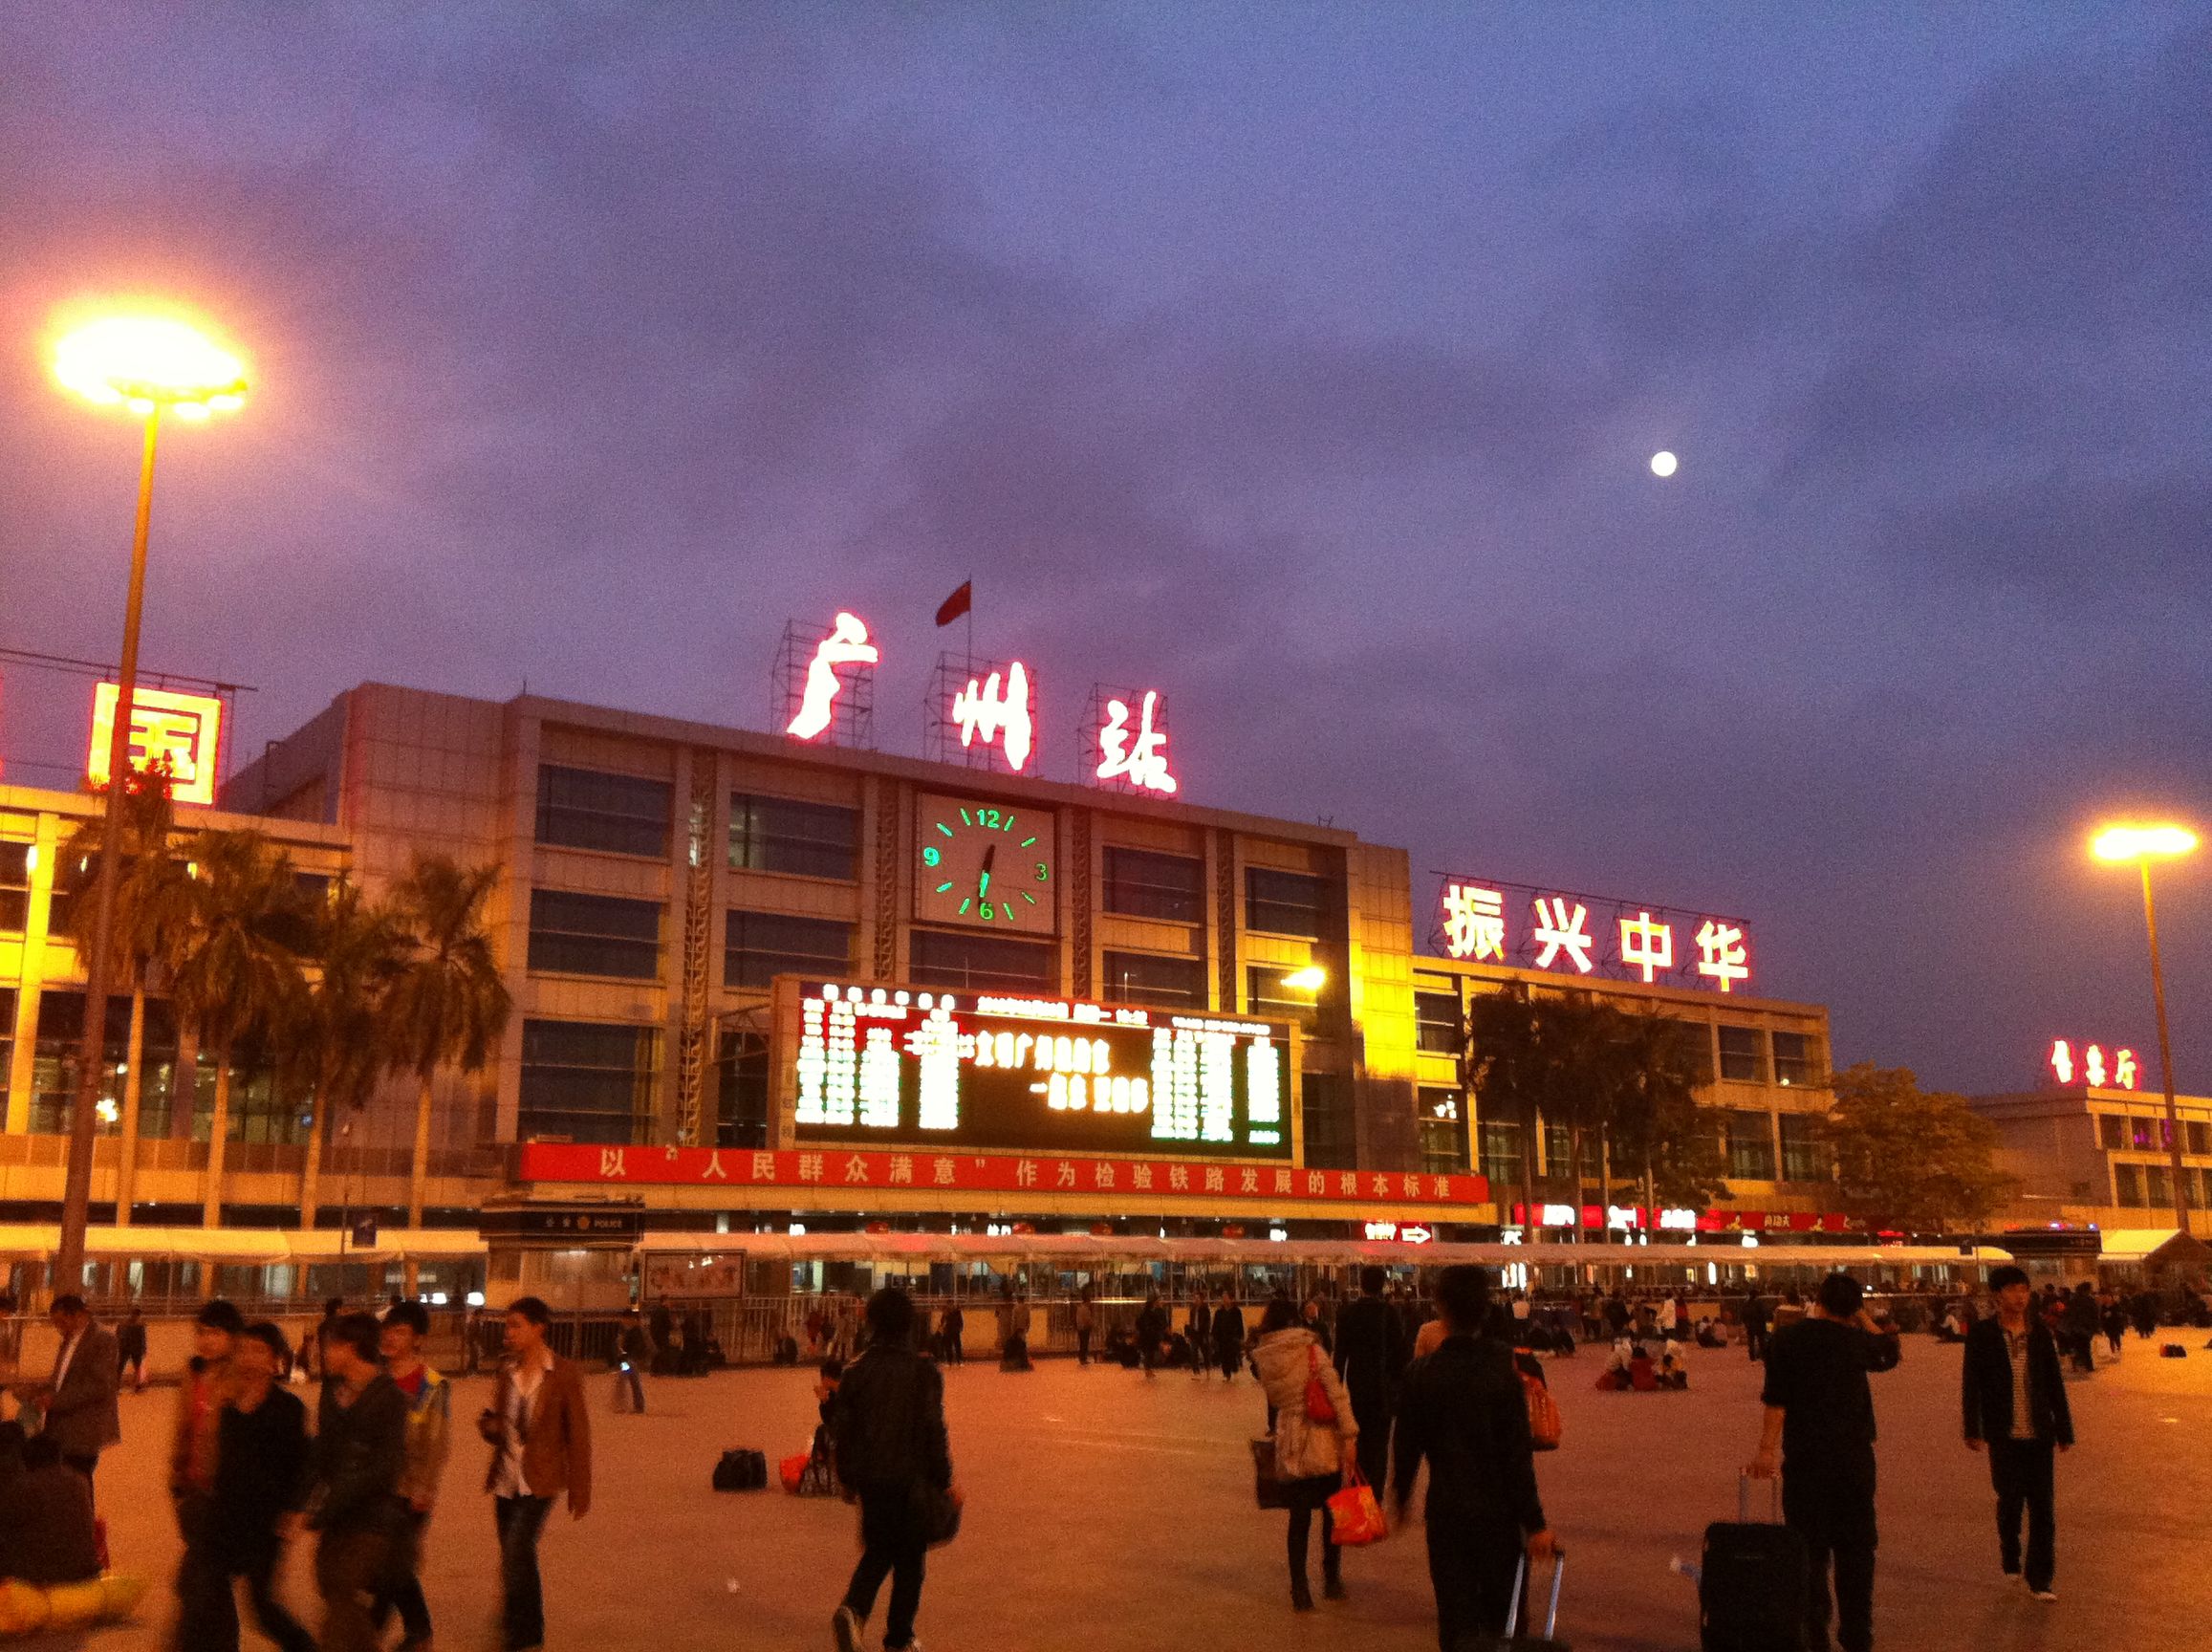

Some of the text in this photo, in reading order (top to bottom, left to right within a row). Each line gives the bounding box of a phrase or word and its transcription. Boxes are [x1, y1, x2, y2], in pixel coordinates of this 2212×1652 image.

[786, 611, 1178, 794] 广州站
[87, 681, 223, 806] 国
[976, 809, 1000, 830] 12
[922, 847, 940, 866] 9
[1035, 863, 1048, 881] 3
[979, 902, 994, 921] 6
[1442, 884, 1749, 992] 振兴中华
